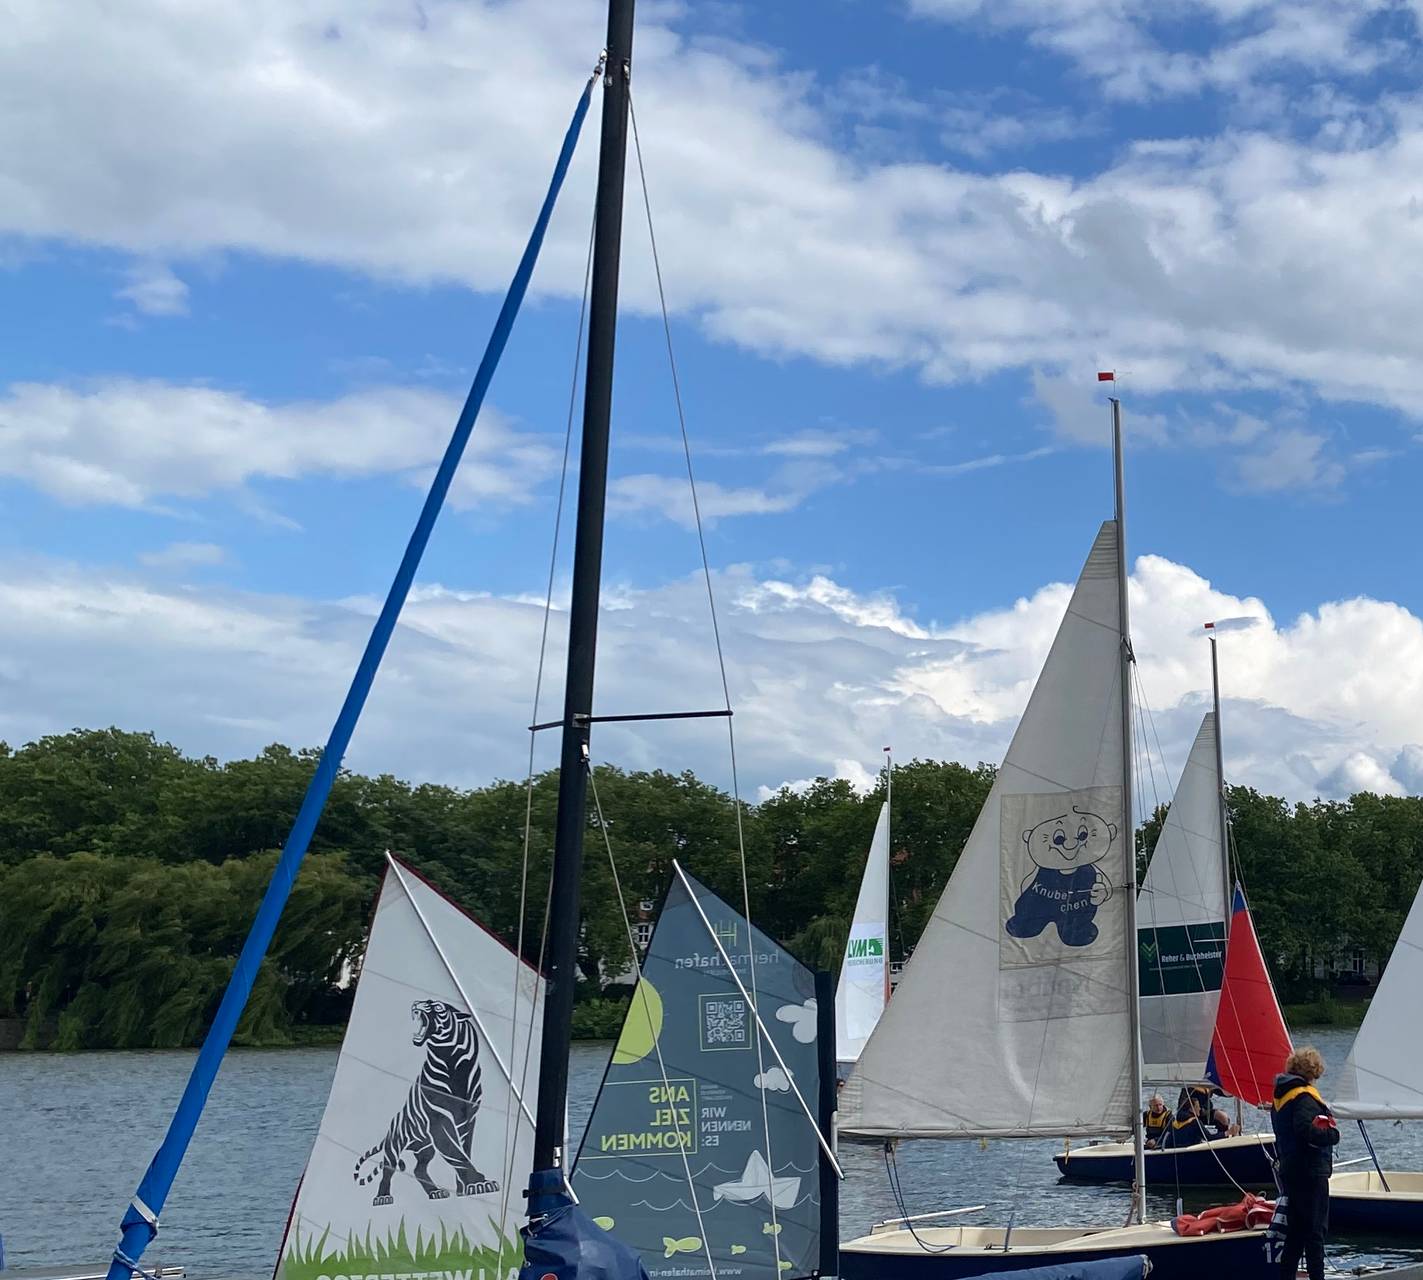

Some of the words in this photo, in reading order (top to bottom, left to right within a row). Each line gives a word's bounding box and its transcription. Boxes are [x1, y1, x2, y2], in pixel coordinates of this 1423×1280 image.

[1060, 899, 1088, 913] chen
[847, 939, 867, 958] LVM
[1262, 1241, 1285, 1263] 12
